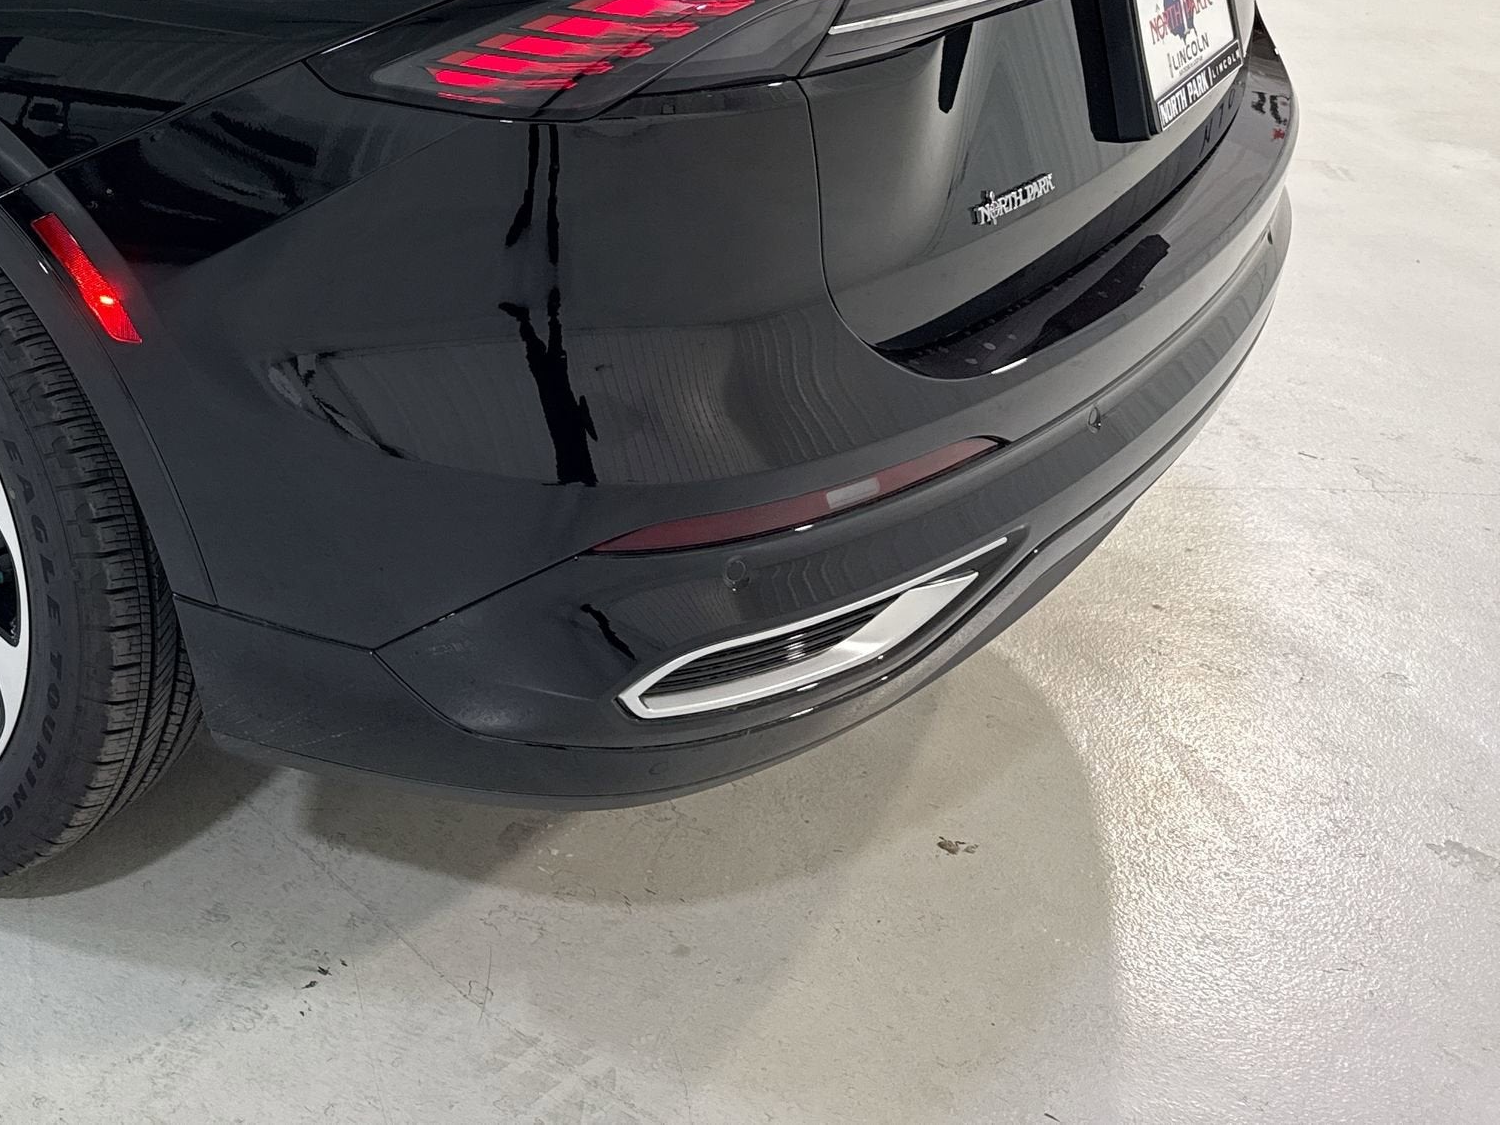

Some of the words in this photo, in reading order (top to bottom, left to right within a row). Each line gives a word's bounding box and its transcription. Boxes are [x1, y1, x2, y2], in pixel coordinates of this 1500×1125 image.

[1149, 1, 1183, 46] NORTH
[1172, 31, 1210, 71] LINCOLN
[1159, 87, 1188, 126] NORTH
[1187, 69, 1209, 104] PARK
[1023, 173, 1055, 203] PARK
[2, 438, 62, 625] EAGLE
